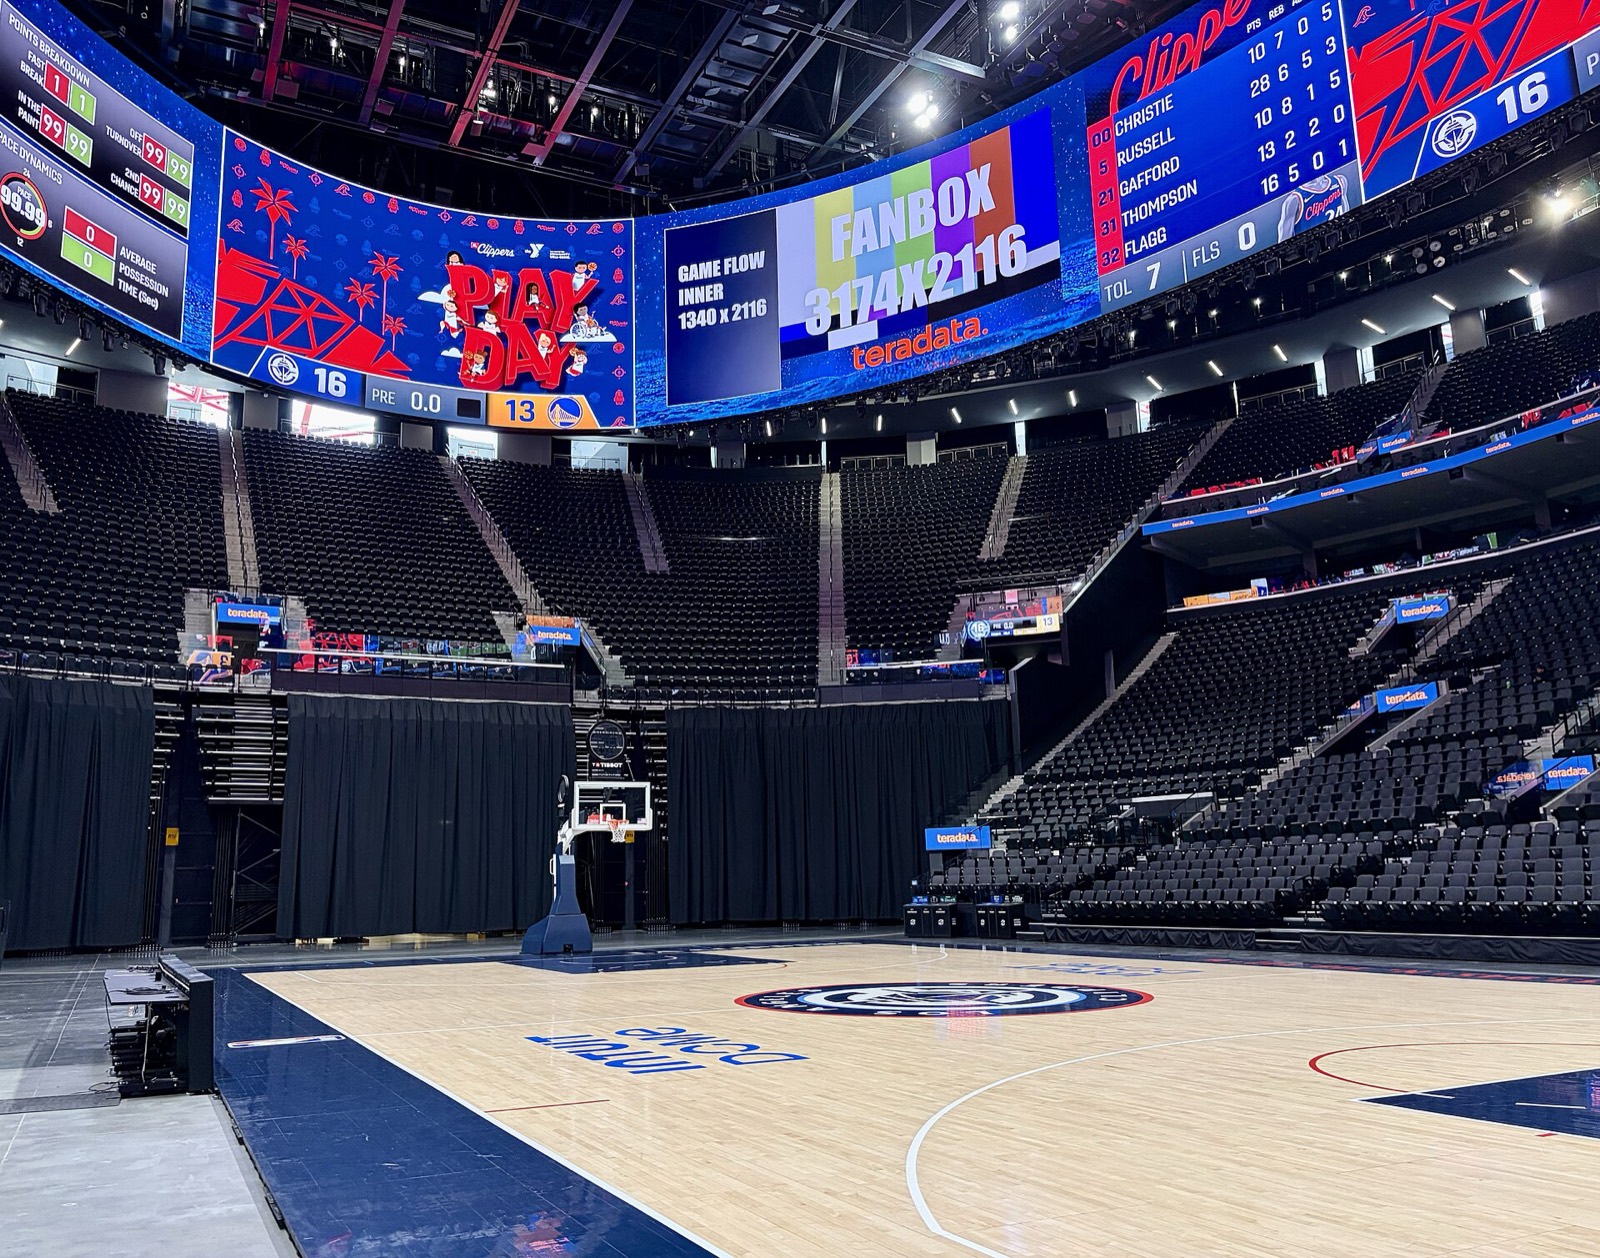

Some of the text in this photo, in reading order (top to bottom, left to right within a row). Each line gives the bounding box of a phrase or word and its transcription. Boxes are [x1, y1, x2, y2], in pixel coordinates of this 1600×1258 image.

[1246, 4, 1285, 34] PTS REB
[8, 13, 90, 88] POINTS BREAKDOWN
[28, 50, 45, 70] FAST
[20, 60, 44, 88] BREAK
[54, 75, 60, 93] 1
[1092, 2, 1333, 148] 00 CHRISTIE 10 7 0 5
[18, 90, 41, 114] IN THE
[80, 94, 86, 112] 1
[1098, 36, 1337, 176] 5 RUSSELL 28 6 5 3
[1497, 71, 1548, 124] 16
[18, 107, 40, 130] PAINT
[44, 114, 62, 138] 99
[70, 132, 88, 157] 99
[106, 125, 142, 158] TURNOVER
[130, 128, 142, 142] OFF
[1098, 70, 1341, 207] 21 GAFFORD 10 8 1 5
[20, 147, 62, 184] DYNAMICS
[145, 142, 164, 164] 99
[23, 168, 30, 178] 24
[125, 168, 140, 184] 2ND
[170, 160, 188, 180] 99
[1100, 104, 1345, 237] 31 THOMPSON 13 2 2 0
[18, 186, 32, 200] PACE
[110, 172, 138, 198] CHANCE
[142, 183, 161, 204] 99
[0, 185, 45, 228] 99.99
[168, 198, 186, 220] 99
[830, 162, 996, 262] FANBOX
[1101, 138, 1348, 268] 32 FLAGG 16 5 0 1
[17, 236, 24, 247] 12
[86, 226, 94, 242] 0
[84, 252, 92, 268] 0
[120, 246, 157, 274] AVERAGE
[477, 243, 514, 258] Clippers
[530, 244, 544, 258] Y
[1104, 221, 1257, 302] TOL 7 FLS 0
[678, 250, 765, 282] GAME FLOW
[119, 262, 169, 298] POSSESSION
[804, 224, 1027, 338] 3174X2116
[118, 278, 159, 310] TIME (Sec)
[678, 283, 724, 307] INNER
[678, 299, 768, 330] 1340 x 2116
[459, 321, 576, 390] DAY
[853, 316, 988, 370] teradata.
[314, 367, 536, 422] 16 PRE 0.0 13
[1043, 618, 1052, 626] 13
